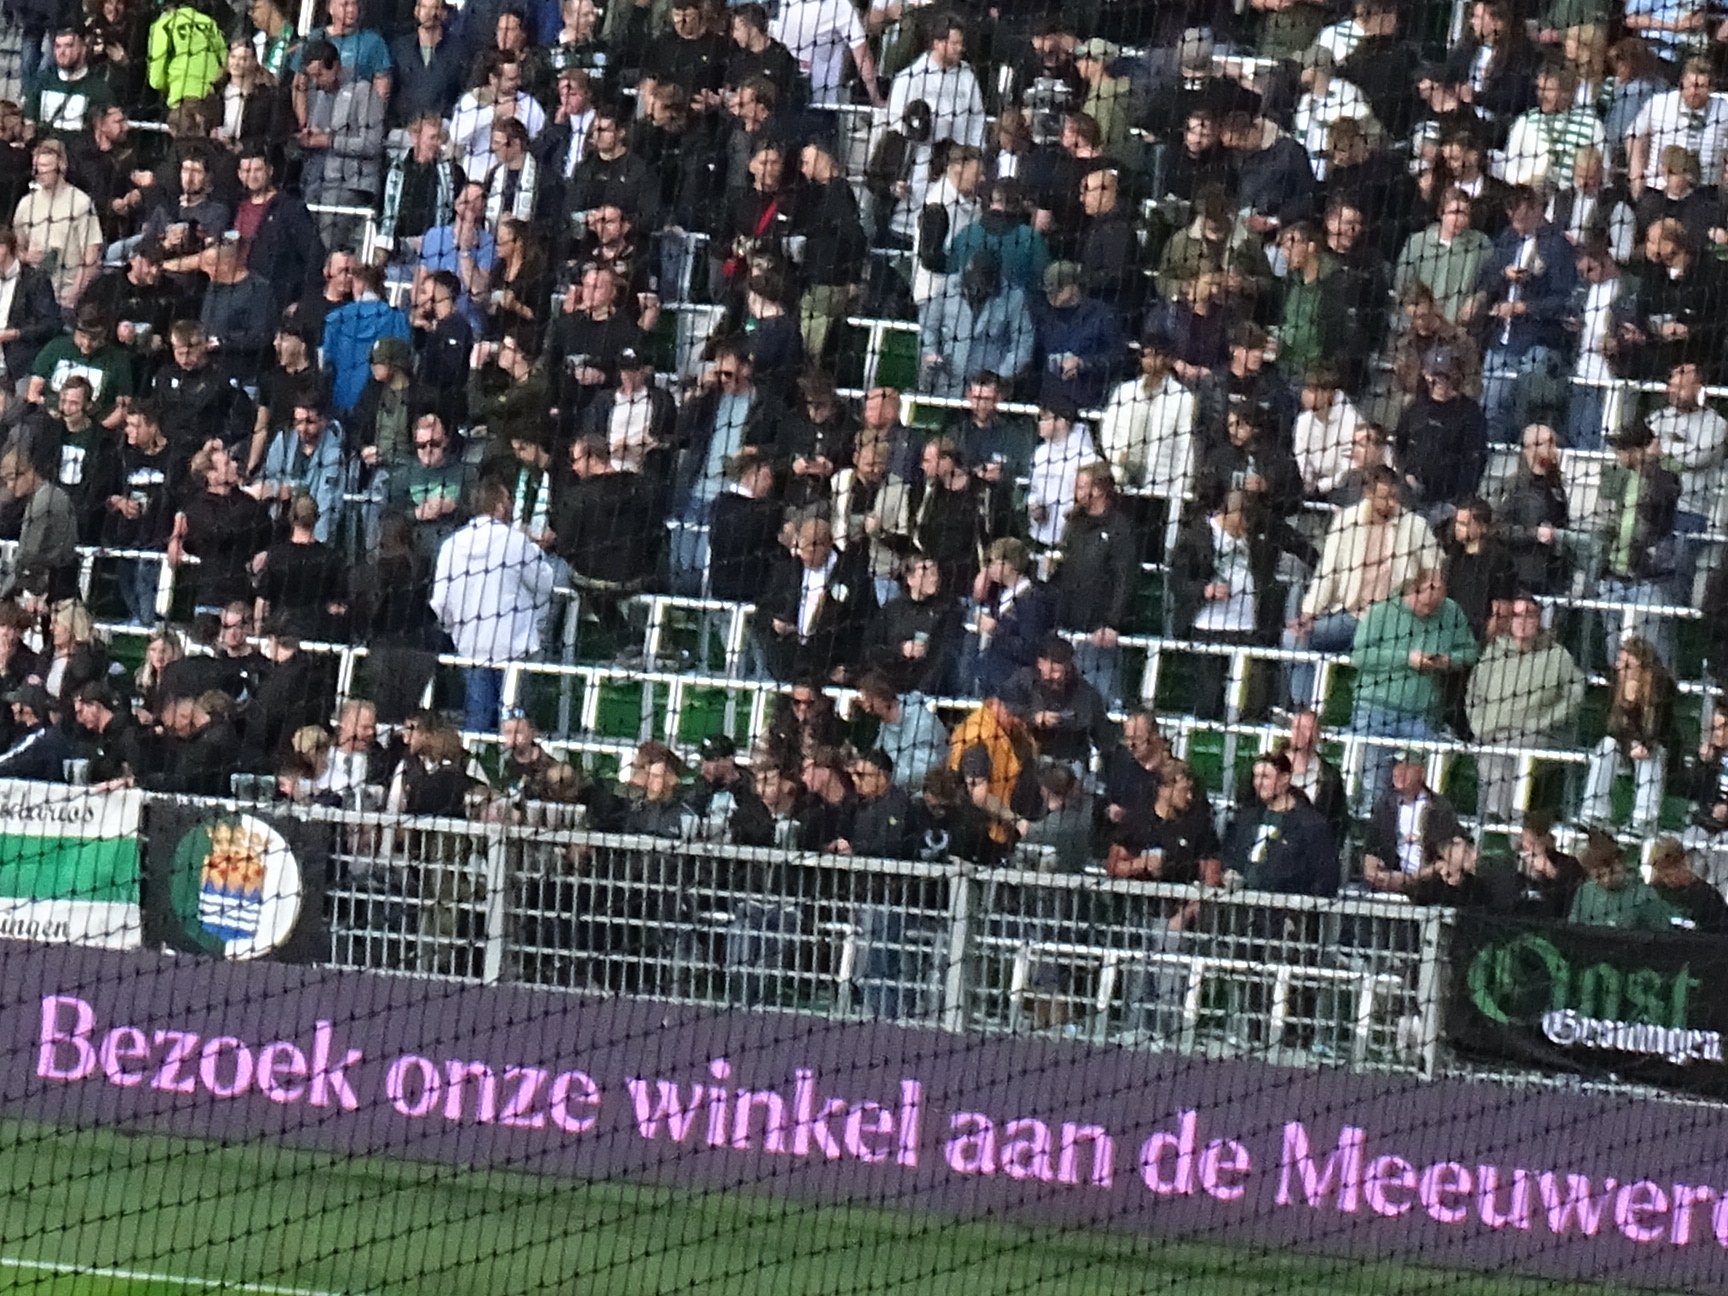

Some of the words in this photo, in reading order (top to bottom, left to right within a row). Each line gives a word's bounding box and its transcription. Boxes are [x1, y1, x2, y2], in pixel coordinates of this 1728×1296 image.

[36, 994, 362, 1111] Bezoek
[385, 1053, 602, 1134] onze
[625, 1059, 922, 1168] winkel
[944, 1108, 1115, 1189] aan
[1140, 1109, 1251, 1201] de
